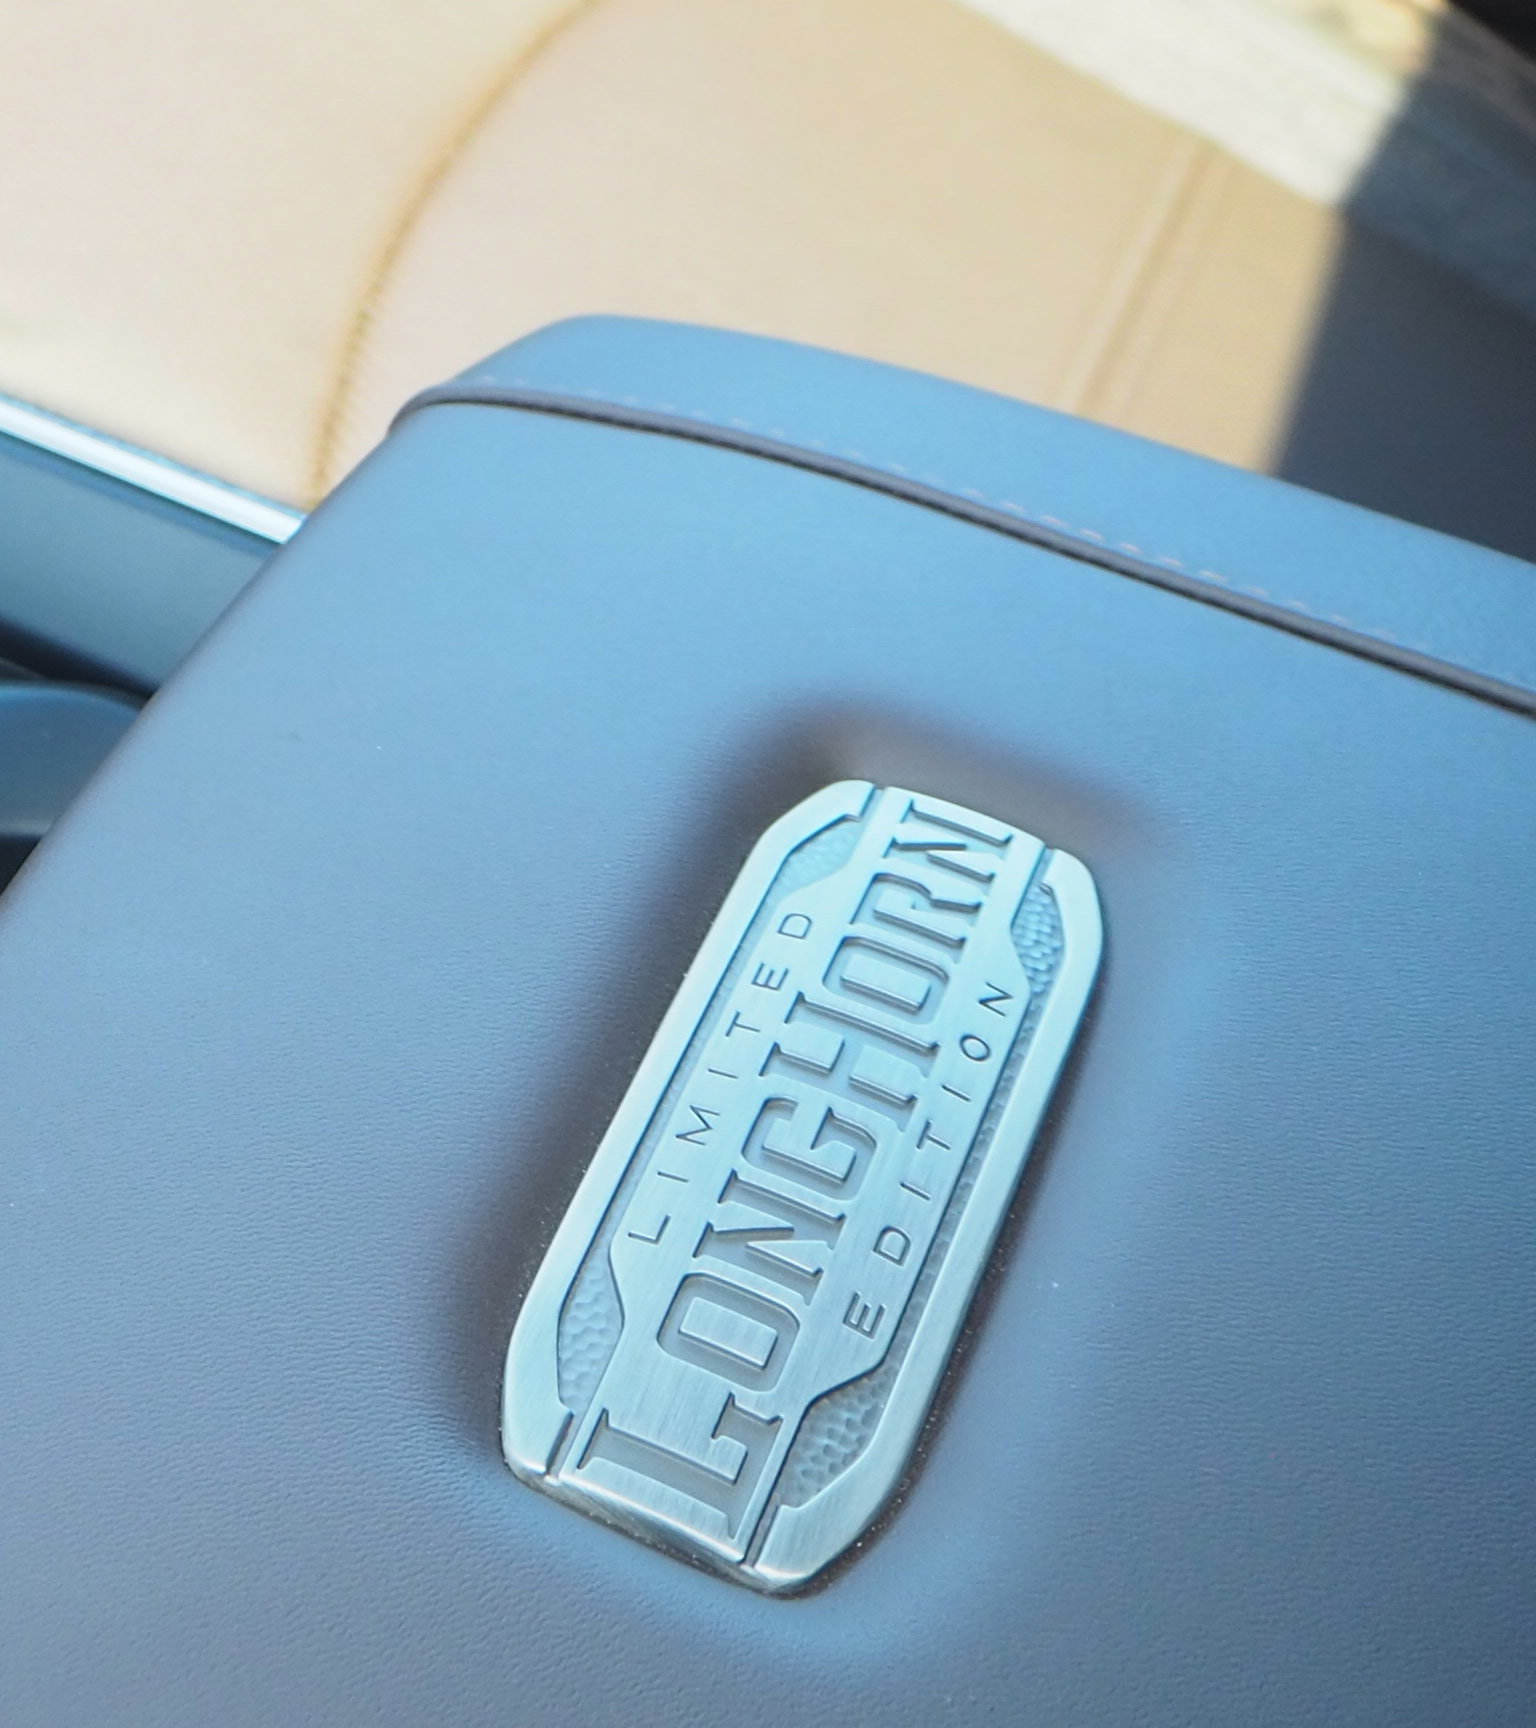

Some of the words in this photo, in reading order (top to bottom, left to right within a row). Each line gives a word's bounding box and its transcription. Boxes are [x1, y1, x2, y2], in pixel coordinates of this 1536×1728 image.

[576, 798, 1016, 1539] LONGHORN
[629, 912, 814, 1244] LIMITED
[845, 982, 1015, 1340] EDITION
